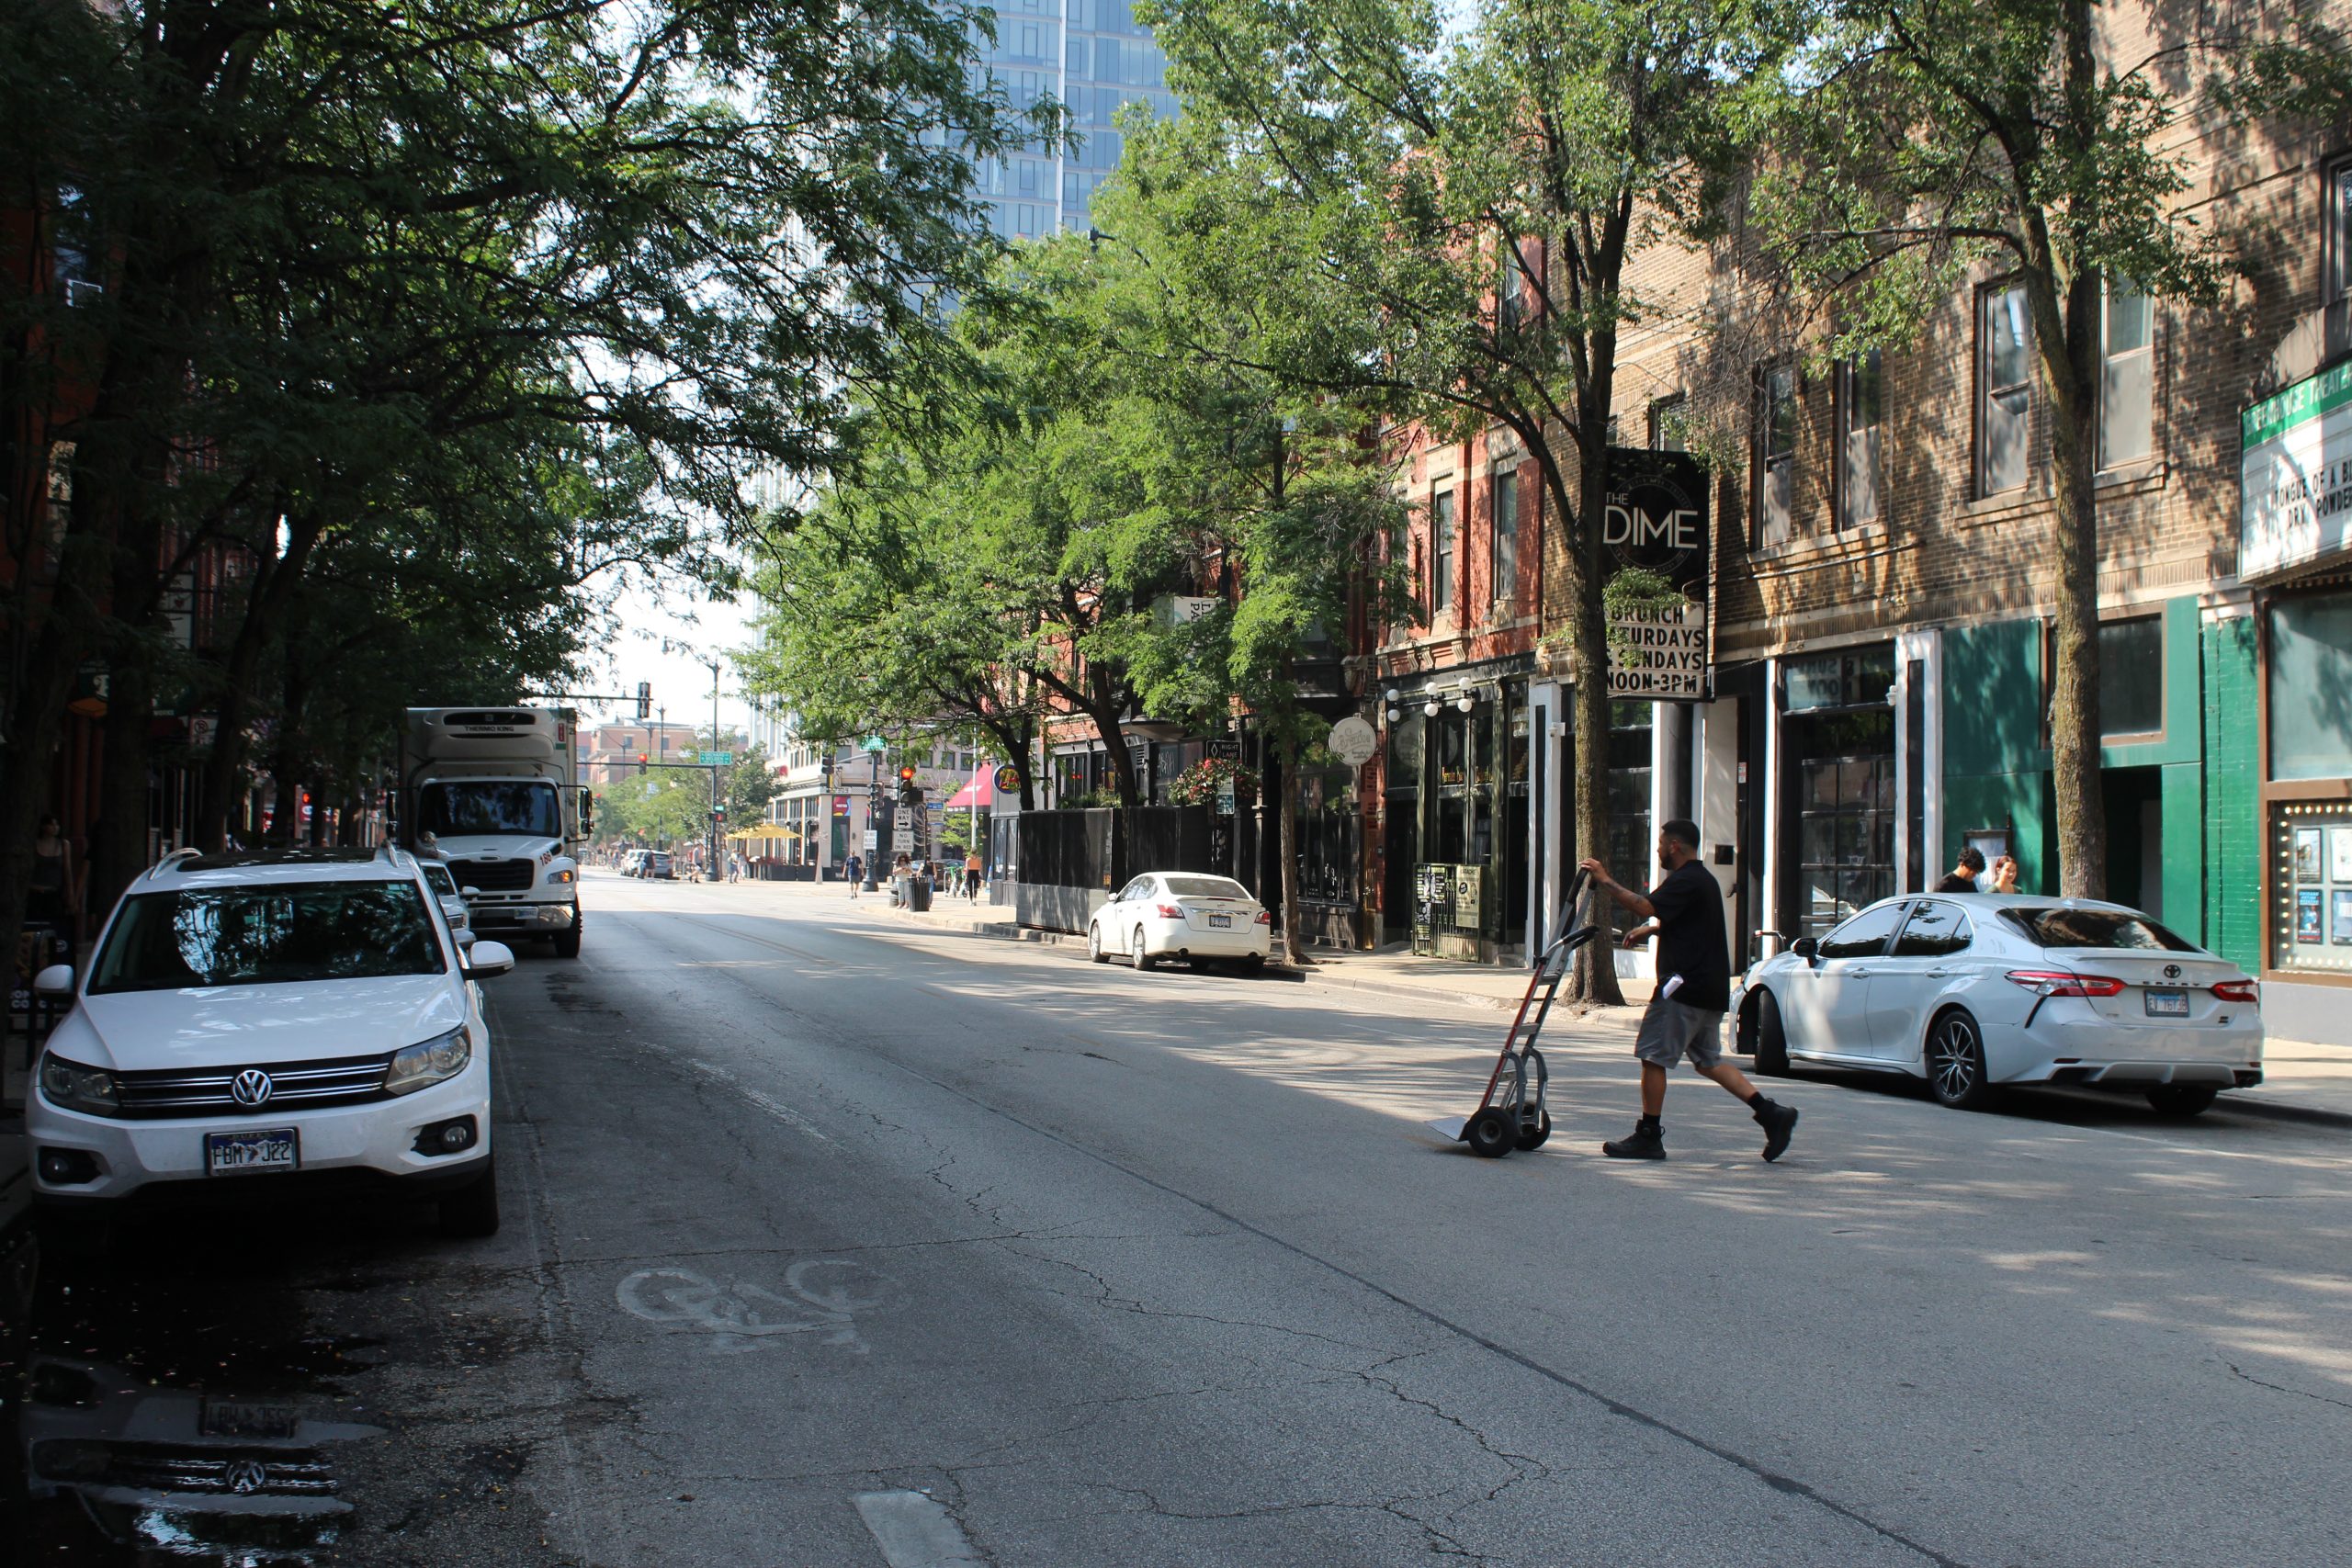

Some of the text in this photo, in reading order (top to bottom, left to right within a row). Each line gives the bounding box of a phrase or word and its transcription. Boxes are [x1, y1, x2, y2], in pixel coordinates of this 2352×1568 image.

[2312, 471, 2324, 494] OF
[2330, 467, 2336, 490] A
[1606, 491, 1630, 505] THE
[1603, 505, 1699, 549] DIME
[1607, 671, 1697, 693] NOON-3PM
[262, 1142, 290, 1162] J22
